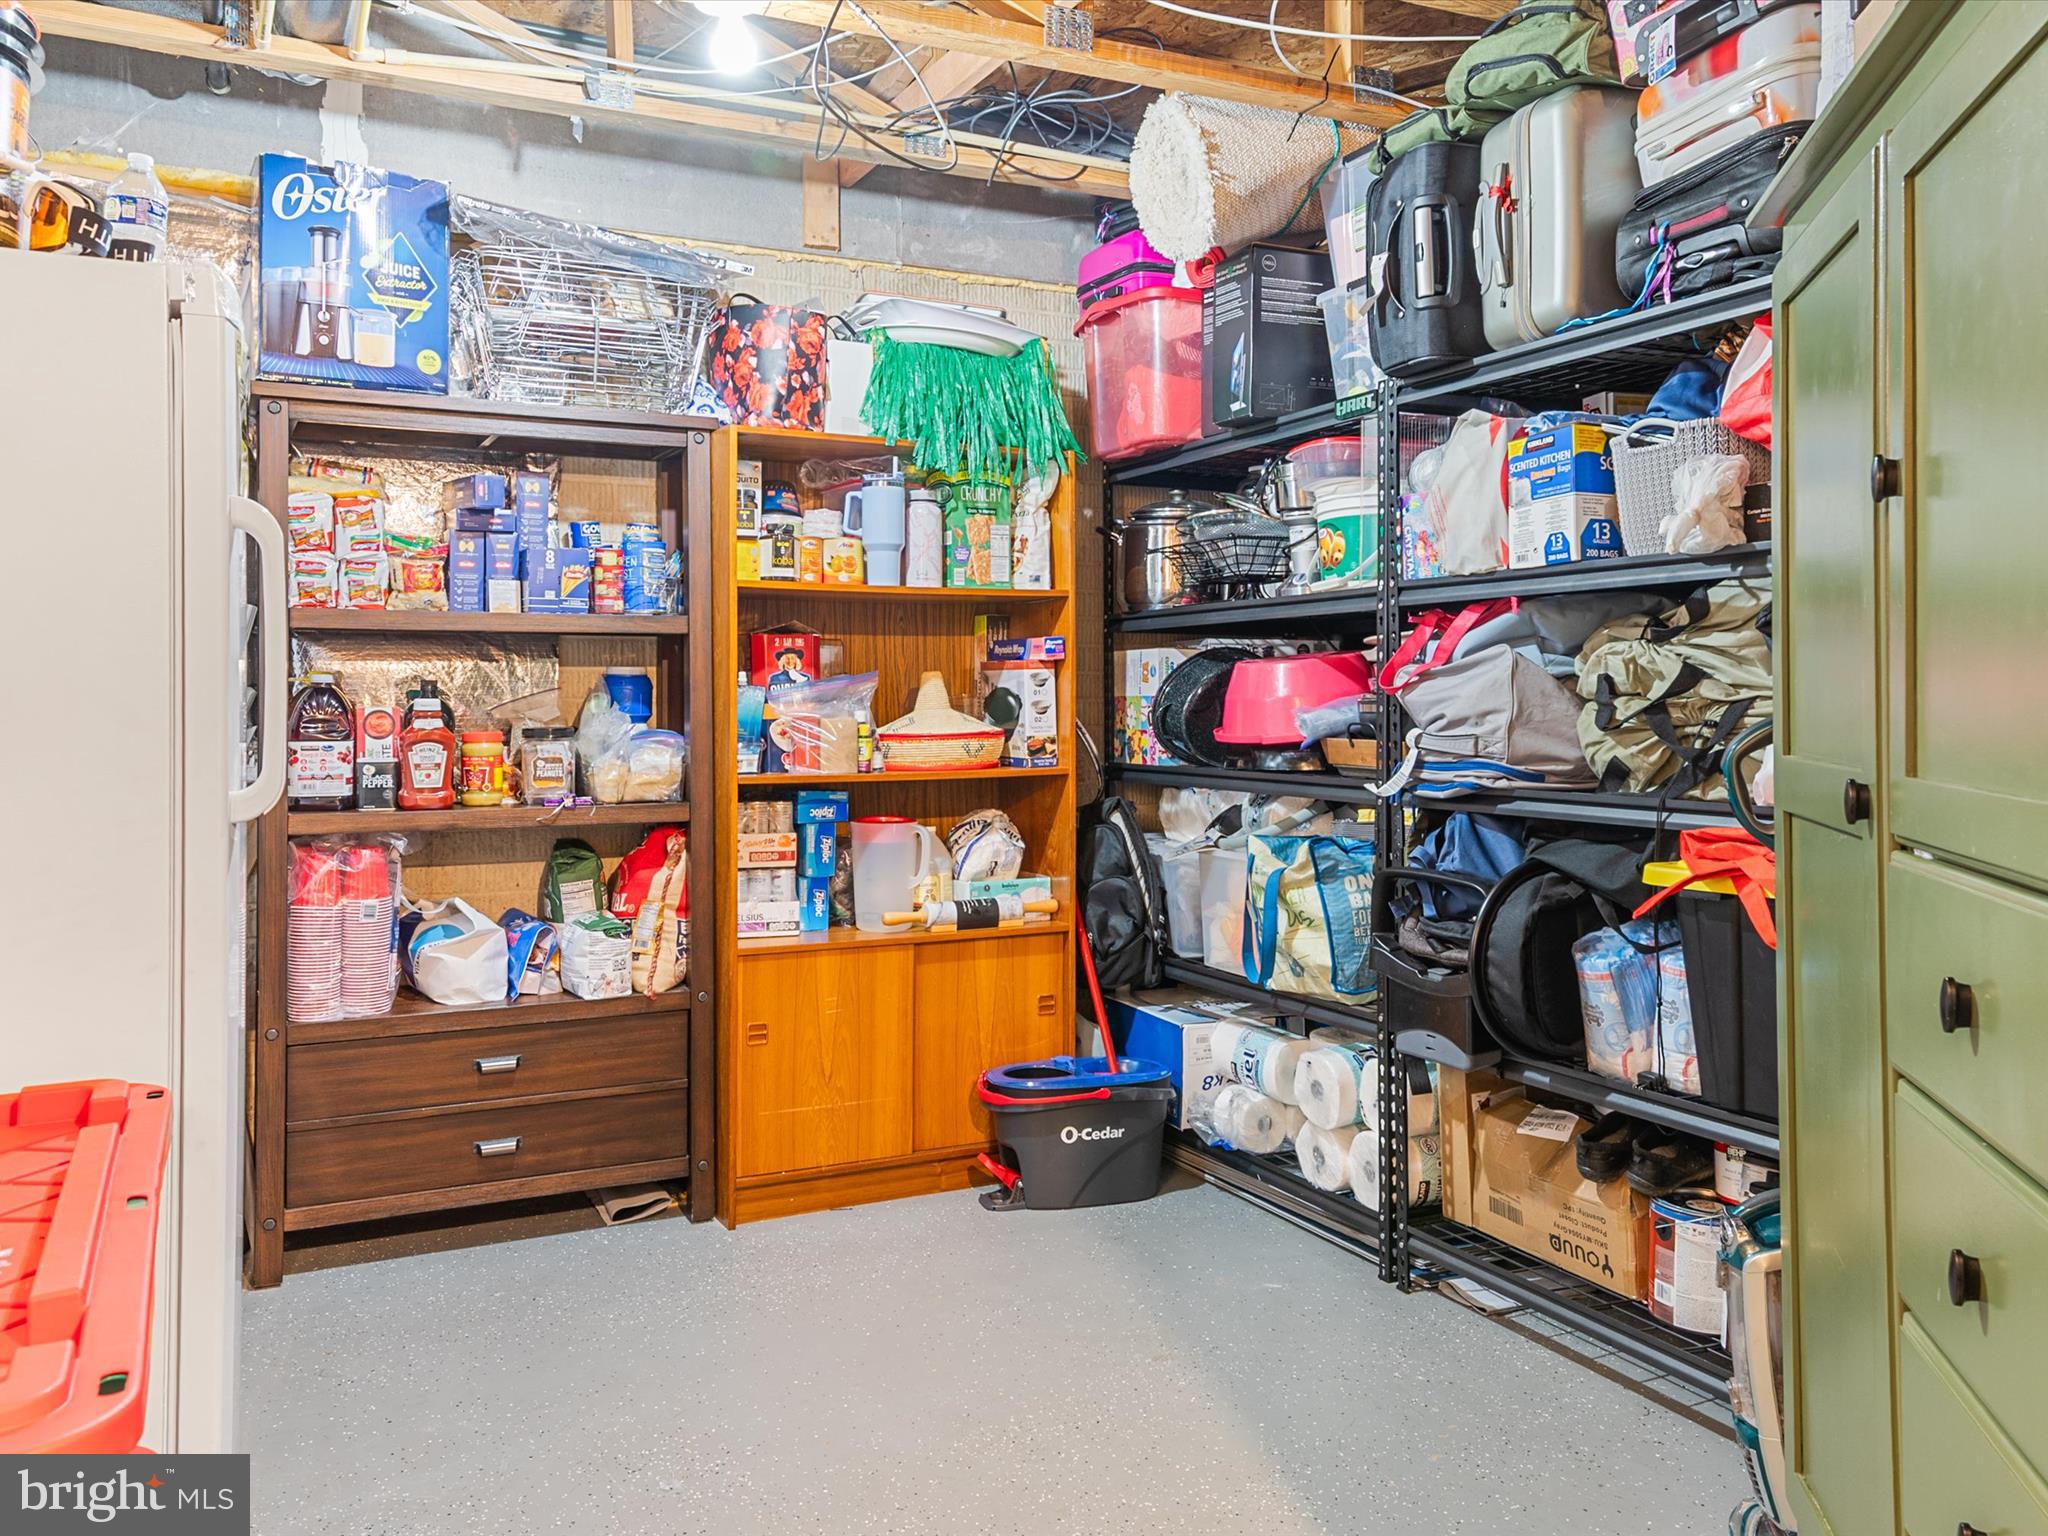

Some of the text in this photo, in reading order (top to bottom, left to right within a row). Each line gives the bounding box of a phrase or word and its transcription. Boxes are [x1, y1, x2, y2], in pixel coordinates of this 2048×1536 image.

[381, 262, 421, 280] JUICE
[1336, 394, 1375, 416] HART
[1510, 458, 1539, 474] SCENTED
[1540, 449, 1571, 466] KITCHEN
[1557, 463, 1572, 473] Bags
[960, 486, 1002, 502] CRUNCHY
[1592, 522, 1611, 540] 13
[1551, 534, 1563, 547] 13
[545, 550, 555, 563] 8
[1404, 526, 1416, 580] CRYSTAL
[1586, 549, 1619, 558] 200 BAGS
[362, 779, 395, 788] PEPPER
[809, 806, 836, 820] Ziploc
[820, 834, 833, 864] Ziploc
[814, 889, 826, 918] Ziploc
[1060, 1126, 1125, 1144] O-Cedar
